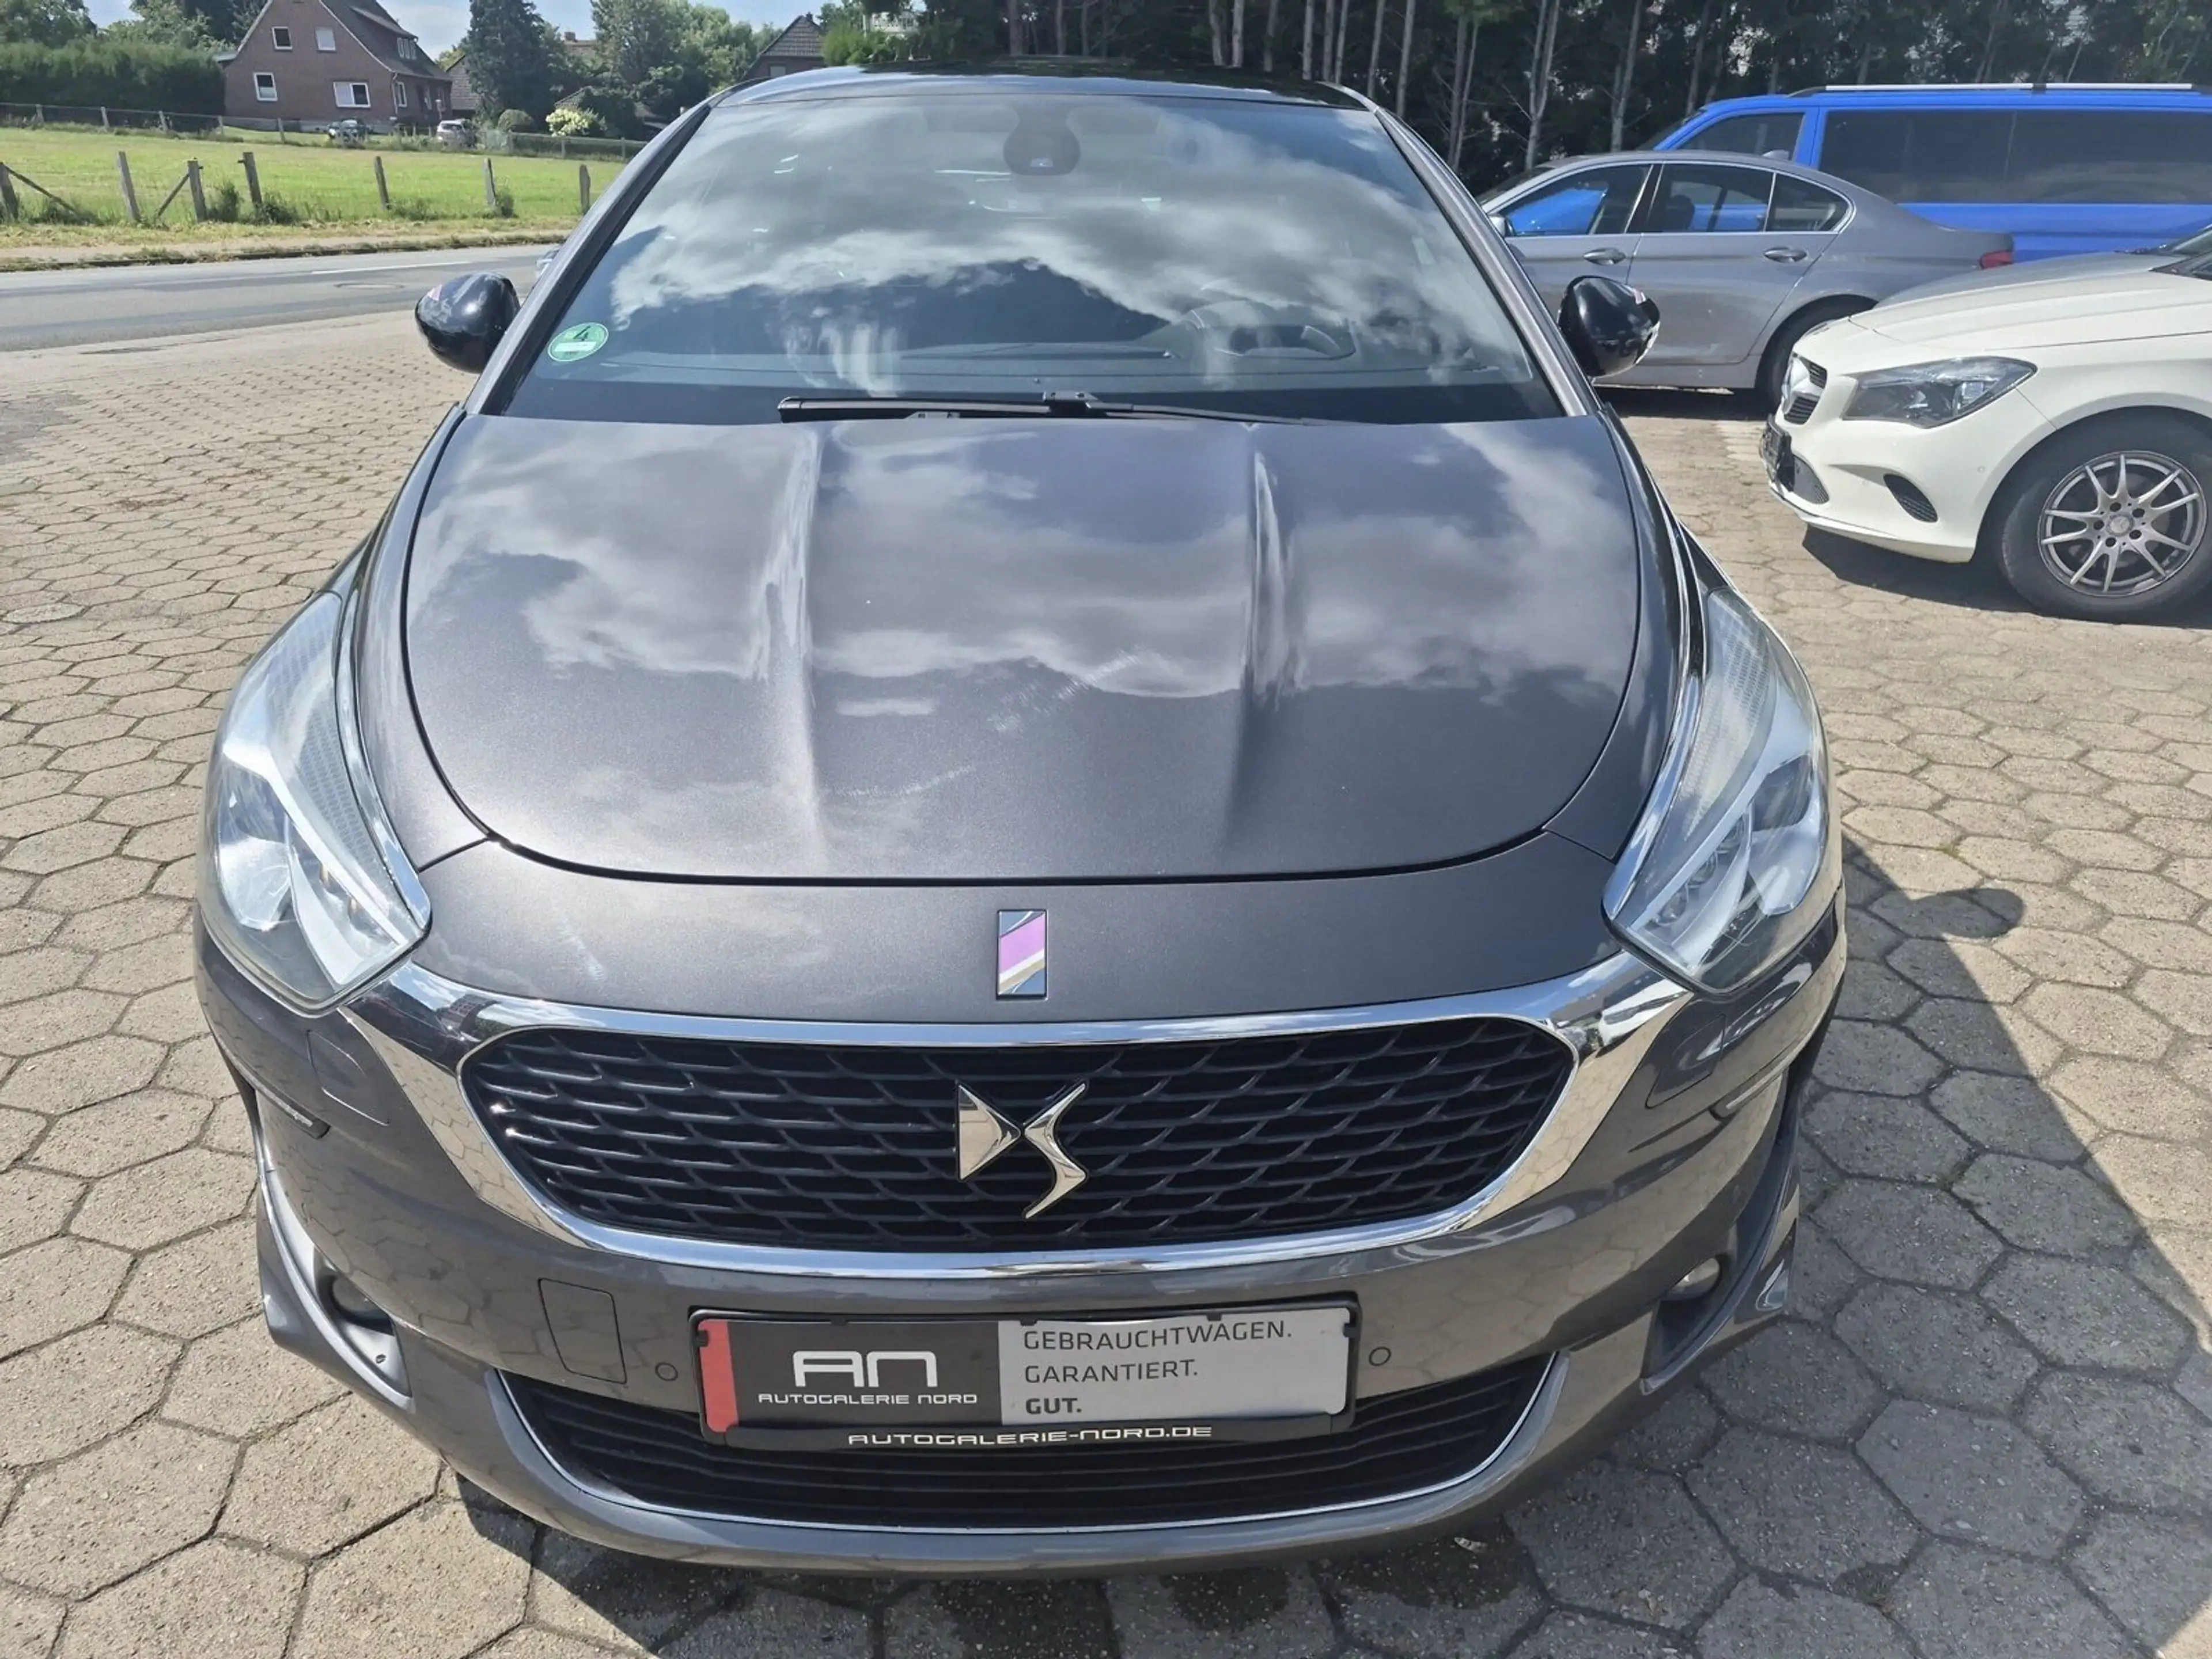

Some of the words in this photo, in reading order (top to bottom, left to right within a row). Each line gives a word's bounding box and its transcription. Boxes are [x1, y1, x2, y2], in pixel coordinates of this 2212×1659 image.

[573, 325, 590, 341] 4
[1024, 1320, 1292, 1350] GEBRAUCHTWAGEN.
[1025, 1358, 1198, 1384] GARANTIERT.
[757, 1393, 910, 1404] AUTOGALERIE
[918, 1394, 978, 1404] NORD
[1025, 1397, 1082, 1415] GUT.
[849, 1426, 1212, 1445] AUTOGALERIE-NORD.DE
